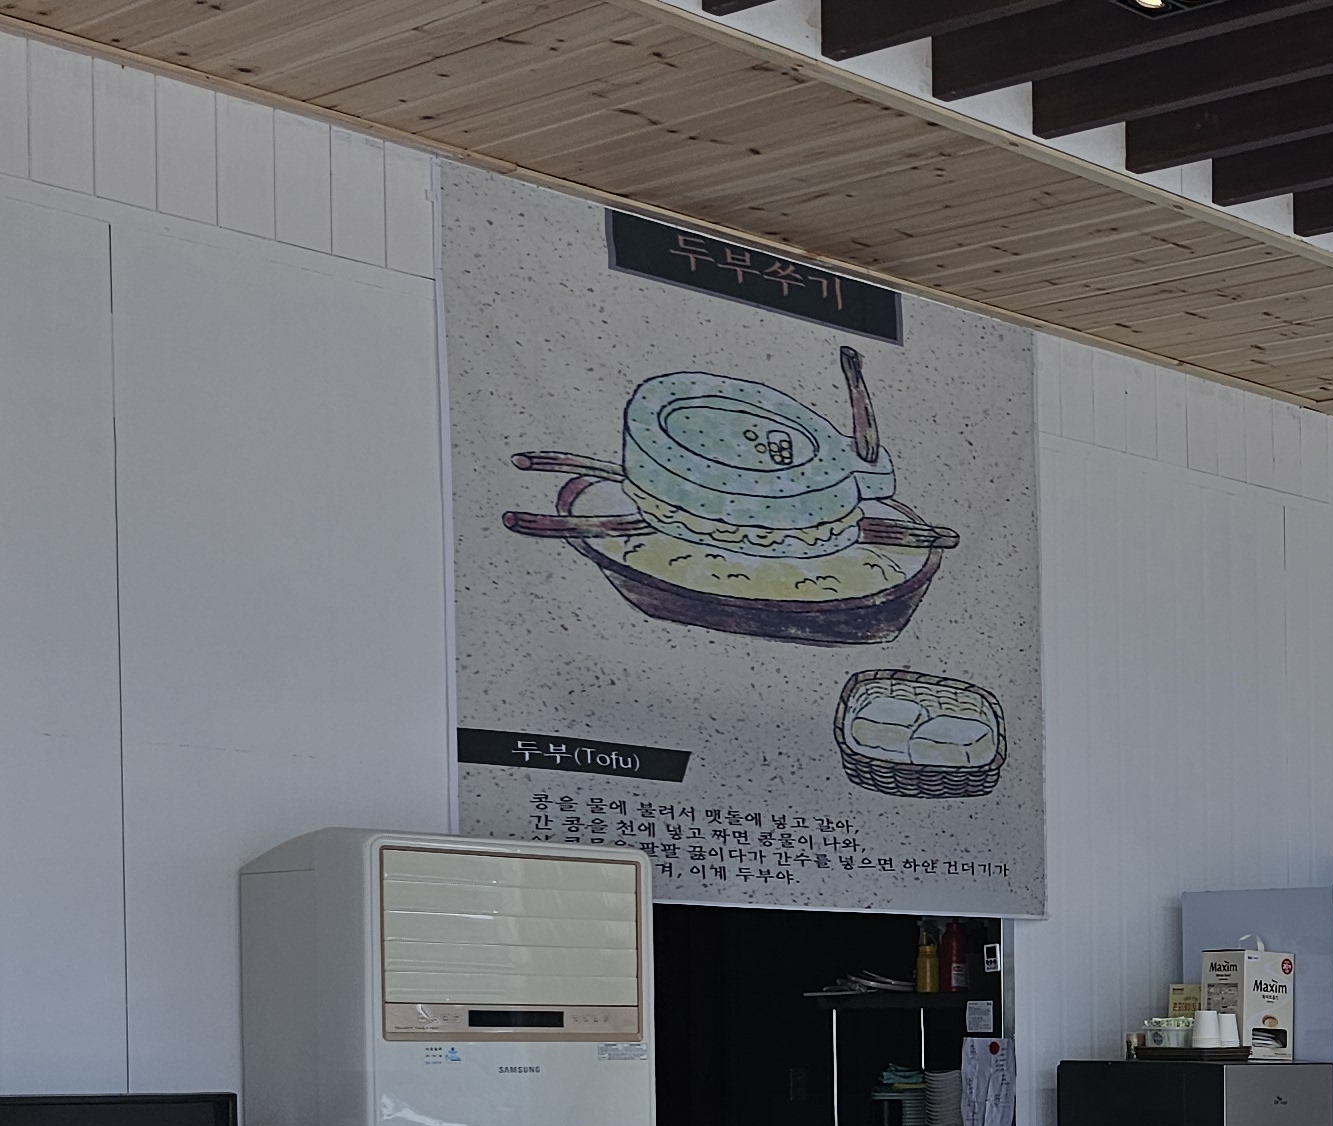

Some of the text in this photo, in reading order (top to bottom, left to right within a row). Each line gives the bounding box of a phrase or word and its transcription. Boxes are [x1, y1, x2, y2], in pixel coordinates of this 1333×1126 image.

[669, 234, 843, 310] 두부쑤기
[511, 740, 640, 772] 두부(Tofu)
[530, 793, 860, 834] 콩을 물에 불려서 맷돌에 넣고 갈아,
[530, 814, 866, 854] 간 콩을 천에 넣고 짜면 콩물이 나와,
[686, 844, 766, 865] 끓이다가
[839, 855, 896, 872] 넣으면
[902, 857, 938, 875] 하얀
[943, 859, 1009, 877] 건더기가
[689, 864, 800, 884] 이게 두부야.
[1209, 961, 1238, 972] Maxim
[1253, 979, 1287, 994] Maxim
[498, 1066, 541, 1074] SAMSUNG
